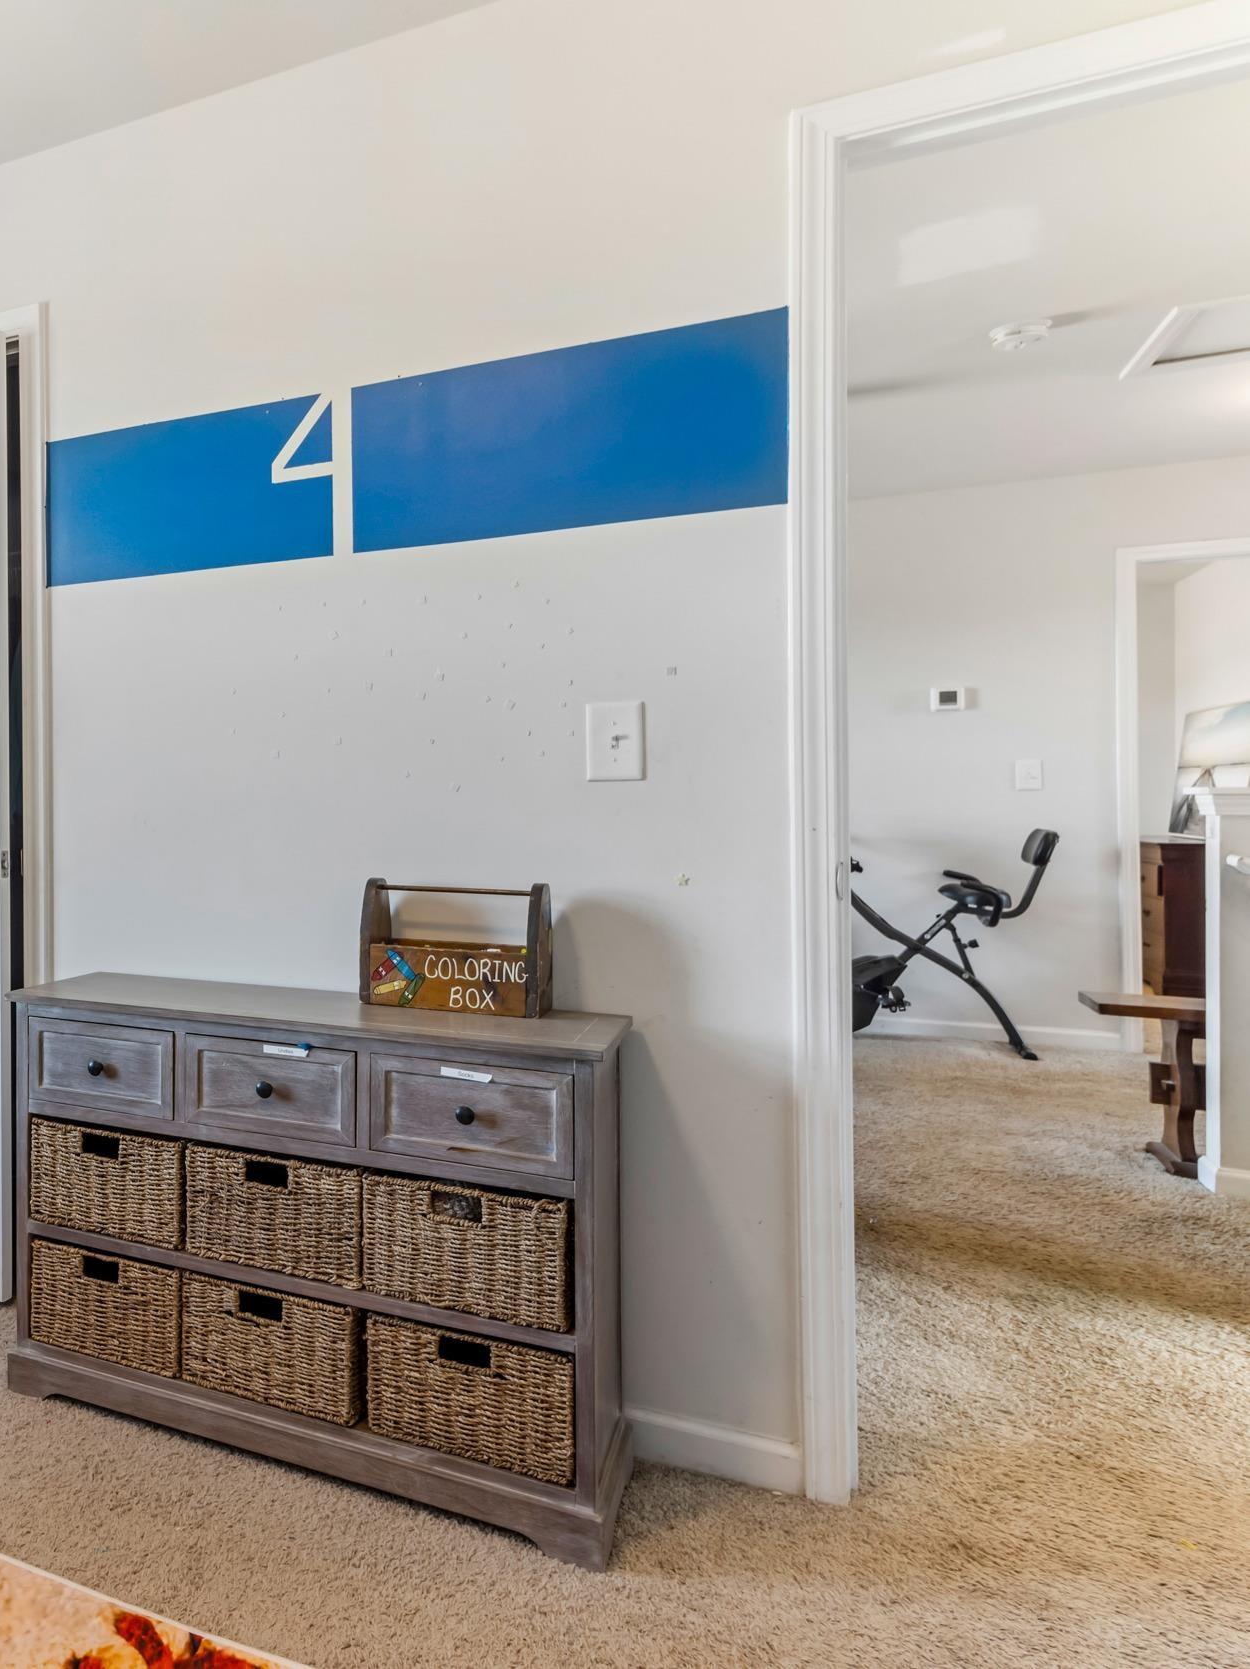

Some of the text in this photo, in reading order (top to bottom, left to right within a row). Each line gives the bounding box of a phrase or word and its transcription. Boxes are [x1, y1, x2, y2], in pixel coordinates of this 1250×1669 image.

[271, 387, 354, 556] 4
[424, 954, 528, 983] COLORING
[449, 986, 495, 1011] BOX
